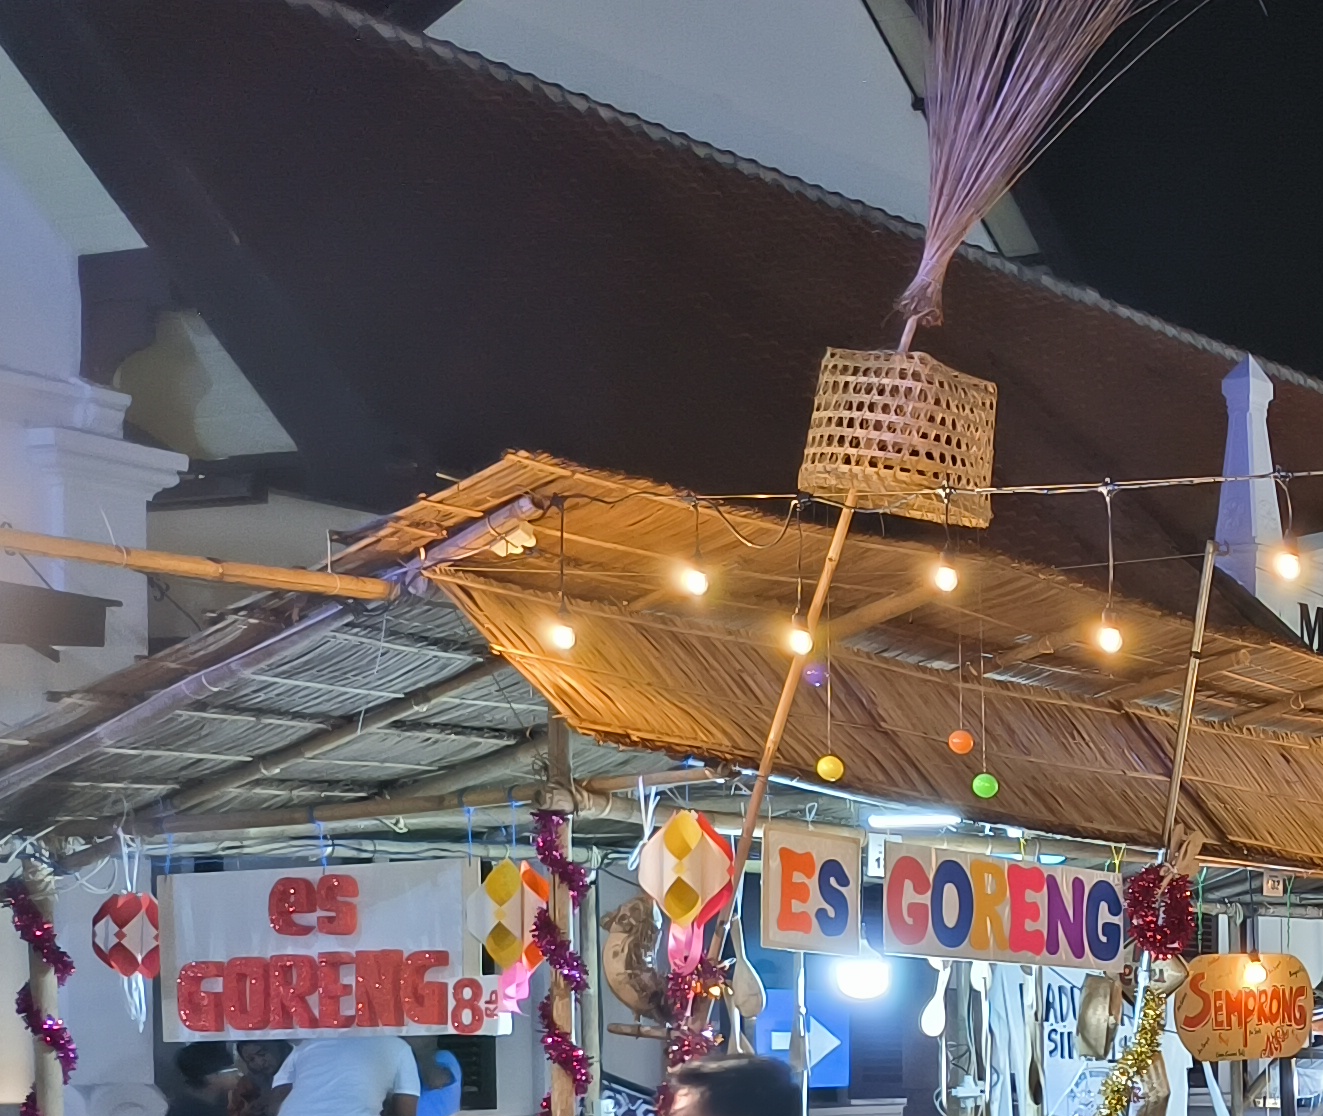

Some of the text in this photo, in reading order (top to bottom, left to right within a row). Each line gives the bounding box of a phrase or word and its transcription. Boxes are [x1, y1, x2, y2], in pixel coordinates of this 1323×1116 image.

[776, 846, 1122, 962] ES GORENG
[177, 949, 450, 1032] GORENG
[451, 977, 484, 1034] 8
[1180, 971, 1307, 1048] SEMPRONG
